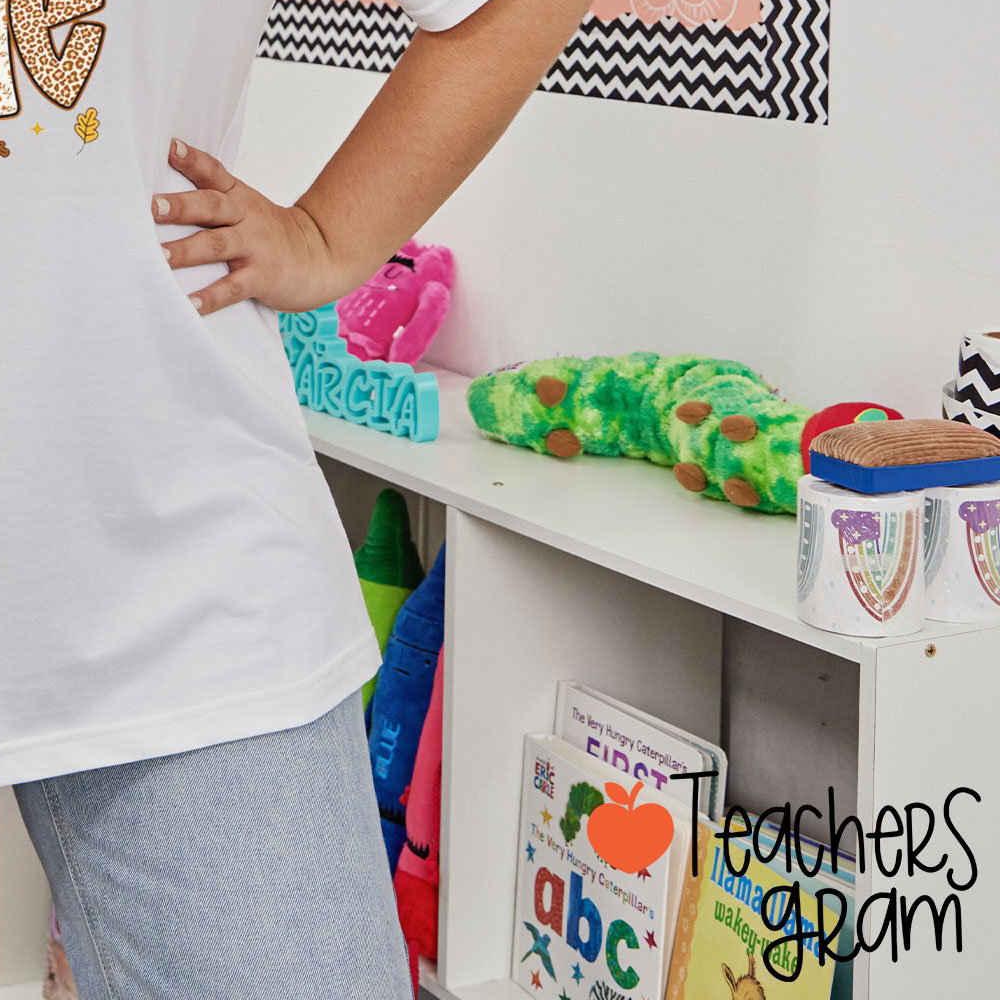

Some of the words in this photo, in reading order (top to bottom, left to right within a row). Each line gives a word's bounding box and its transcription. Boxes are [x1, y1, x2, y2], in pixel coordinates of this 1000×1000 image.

[285, 345, 418, 436] ARCIA
[375, 717, 401, 780] BLUE
[534, 761, 555, 786] ERIC
[572, 706, 586, 724] The
[587, 714, 604, 735] Very
[606, 724, 635, 750] Hungry
[637, 739, 688, 774] Caterpillar's
[533, 775, 555, 800] CARLE
[531, 823, 545, 842] The
[547, 835, 565, 860] Very
[566, 849, 597, 883] Hungry
[598, 873, 655, 920] Caterpillar's
[534, 866, 640, 991] abc
